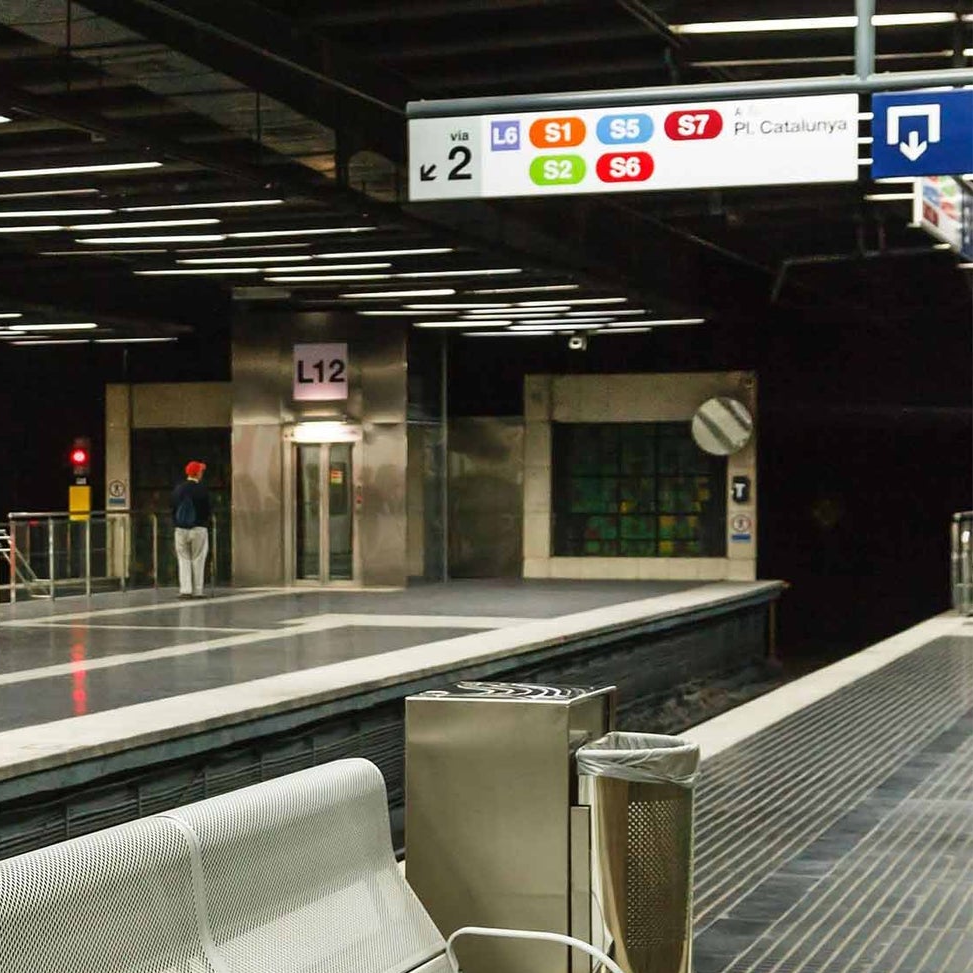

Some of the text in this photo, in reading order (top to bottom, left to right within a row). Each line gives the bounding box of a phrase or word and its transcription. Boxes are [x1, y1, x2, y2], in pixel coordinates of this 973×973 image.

[450, 130, 470, 142] via
[493, 114, 709, 145] L6 S1 S5 S7
[760, 118, 847, 134] Catalunya
[447, 146, 472, 181] 2
[544, 156, 641, 180] S2 S6
[298, 359, 345, 383] L12
